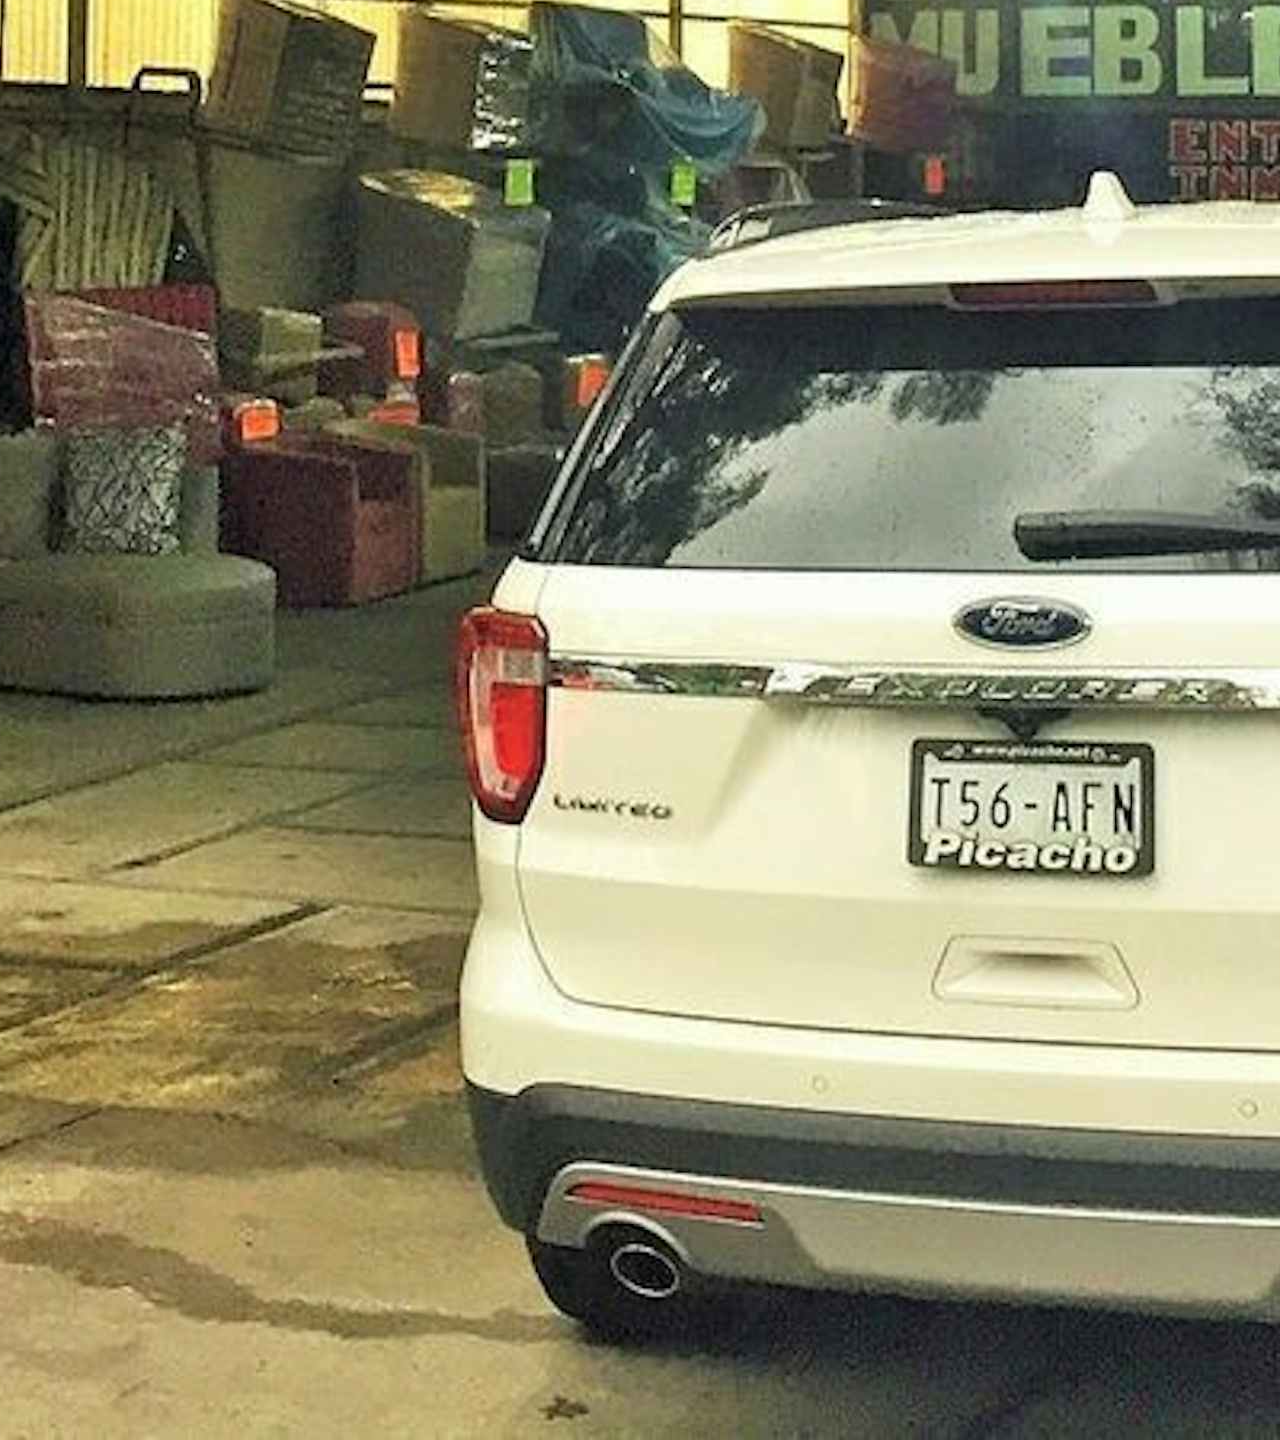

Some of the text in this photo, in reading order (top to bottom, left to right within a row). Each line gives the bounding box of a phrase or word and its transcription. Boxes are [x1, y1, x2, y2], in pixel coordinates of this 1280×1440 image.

[980, 601, 1058, 635] Ford
[840, 672, 1210, 703] EXPLORER
[930, 777, 1135, 834] T56-AFN
[923, 832, 1138, 872] Picacho
